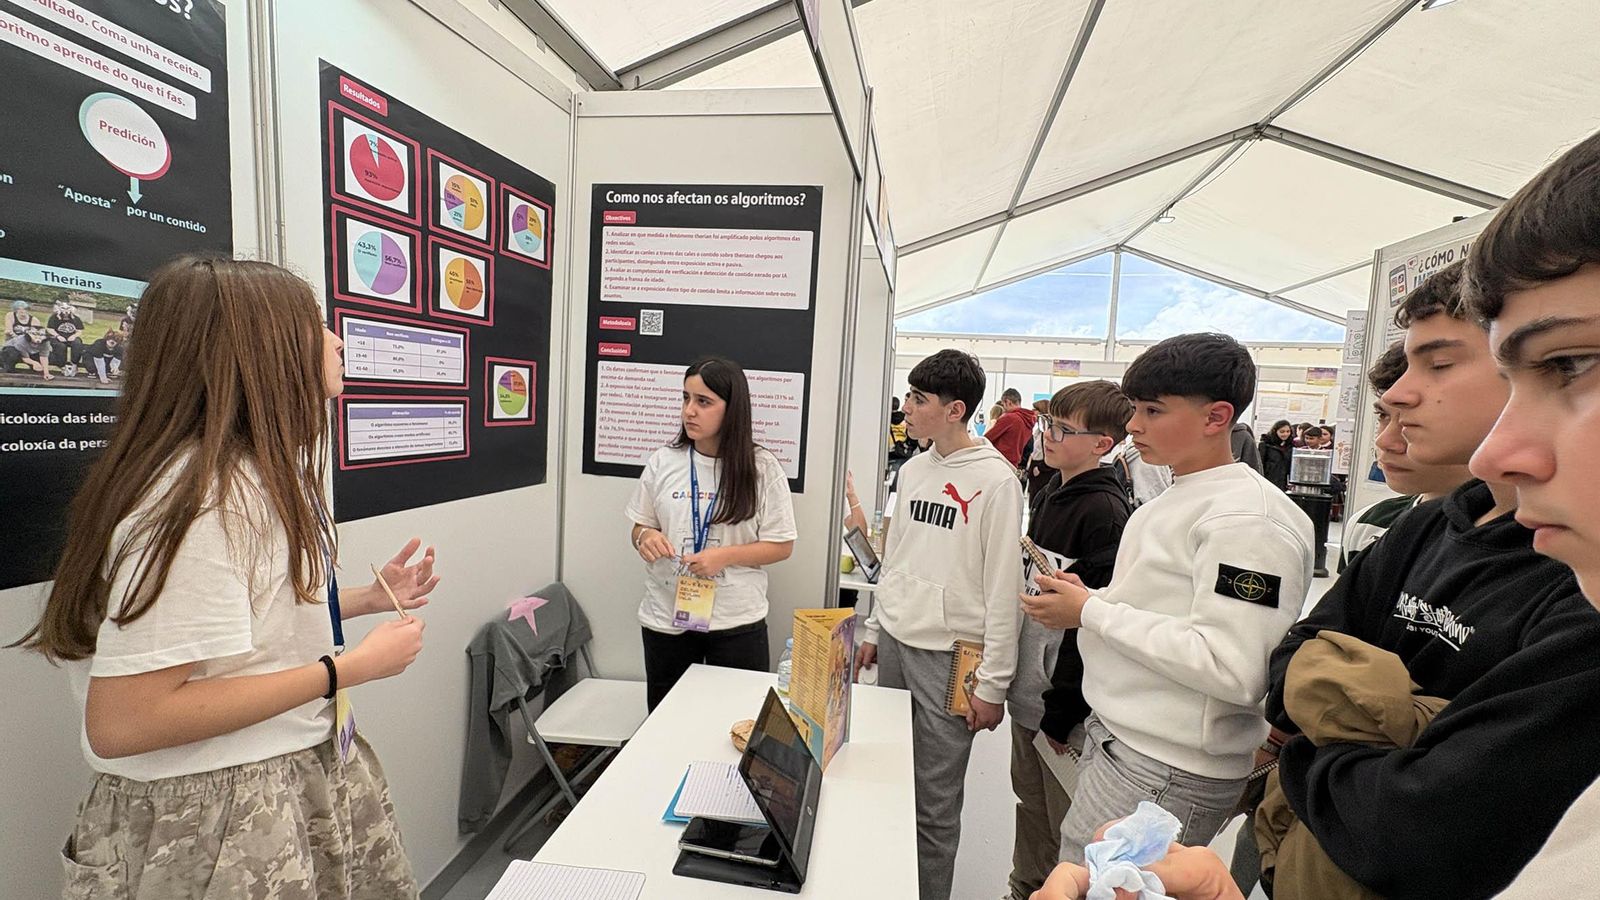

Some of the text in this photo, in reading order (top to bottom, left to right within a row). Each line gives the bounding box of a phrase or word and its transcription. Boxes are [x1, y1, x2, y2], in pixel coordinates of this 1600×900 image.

[33, 0, 202, 80] ultado. Coma unha receita.
[0, 19, 185, 106] oritmo aprende do que ti fas.
[343, 83, 380, 109] Resultados
[99, 120, 156, 149] Predición
[606, 190, 806, 208] Como nos afectan os algoritmos?
[126, 206, 206, 233] por un contido
[358, 241, 376, 251] 43,3%
[1418, 244, 1470, 273] ¿CÓMO N
[41, 270, 102, 289] Therians
[0, 413, 118, 424] icoloxía das iden
[1, 438, 108, 451] coloxía da pers
